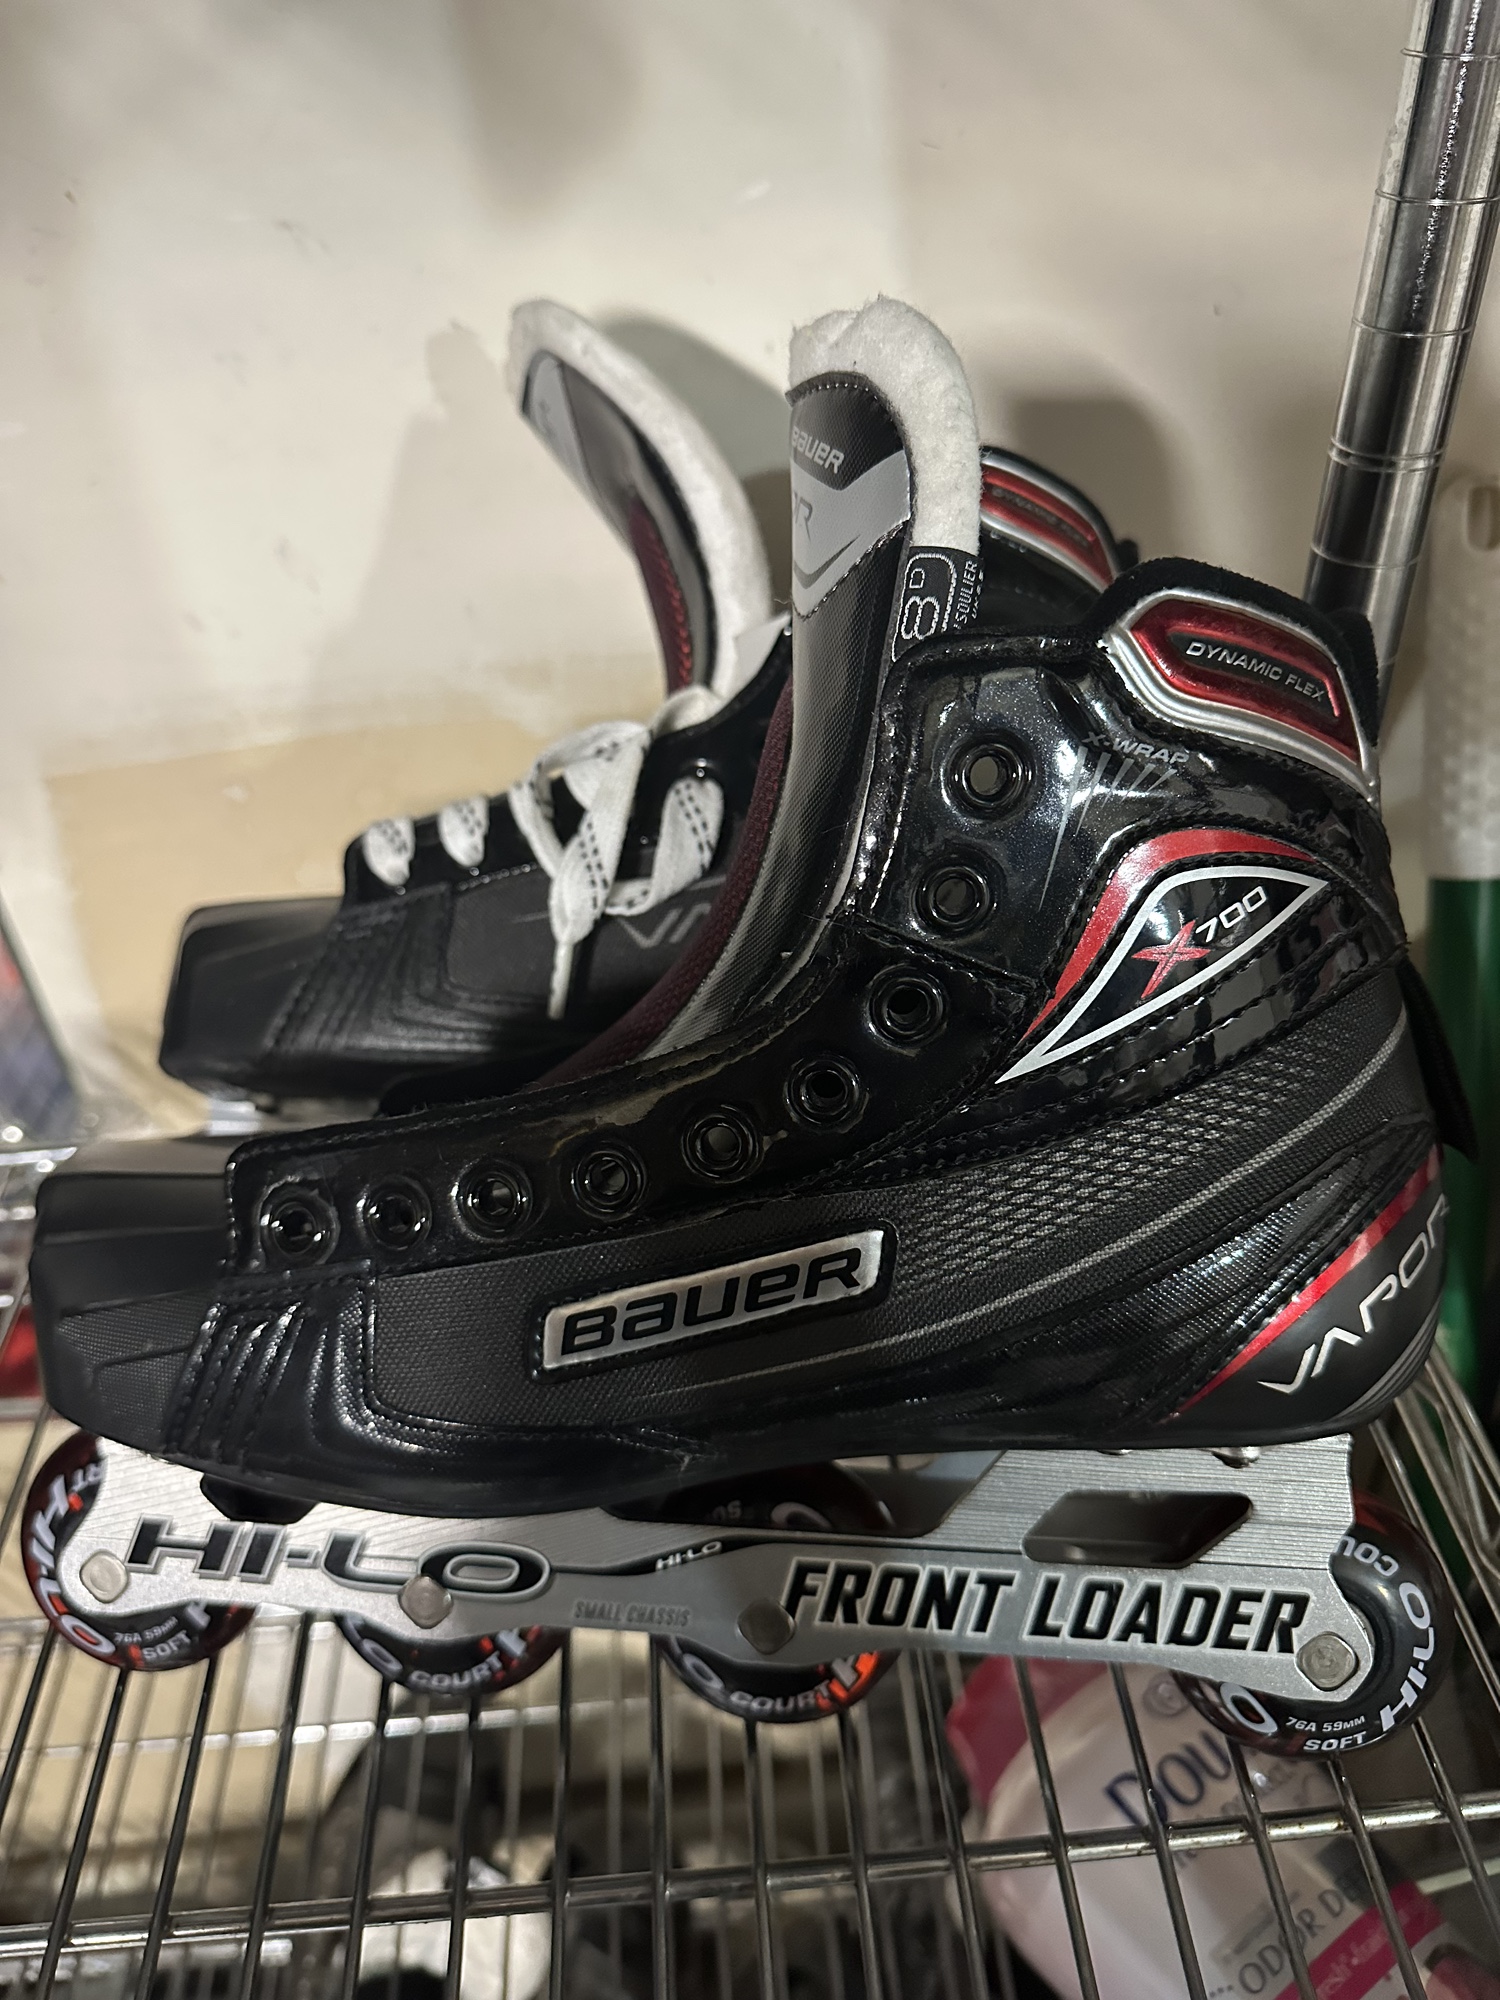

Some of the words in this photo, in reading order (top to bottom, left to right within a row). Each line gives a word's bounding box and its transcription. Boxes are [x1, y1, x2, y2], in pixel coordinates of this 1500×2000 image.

[1186, 641, 1282, 681] DYNAMIC
[1285, 673, 1325, 702] FLEX
[1081, 731, 1190, 765] X-WRAP
[1257, 1193, 1450, 1394] VAPOR
[124, 1513, 551, 1603] HI-LO
[655, 1541, 722, 1571] HI-LO
[1333, 1535, 1400, 1577] COU
[574, 1600, 621, 1621] SMALL
[626, 1604, 691, 1627] CHASSIS
[781, 1557, 1020, 1637] FRONT
[1022, 1572, 1312, 1656] LOADER
[142, 1629, 191, 1662] SOFT
[408, 1651, 503, 1688] COURT
[1285, 1716, 1317, 1732] 76A
[1322, 1715, 1366, 1732] 59MM
[1303, 1731, 1367, 1751] SOFT
